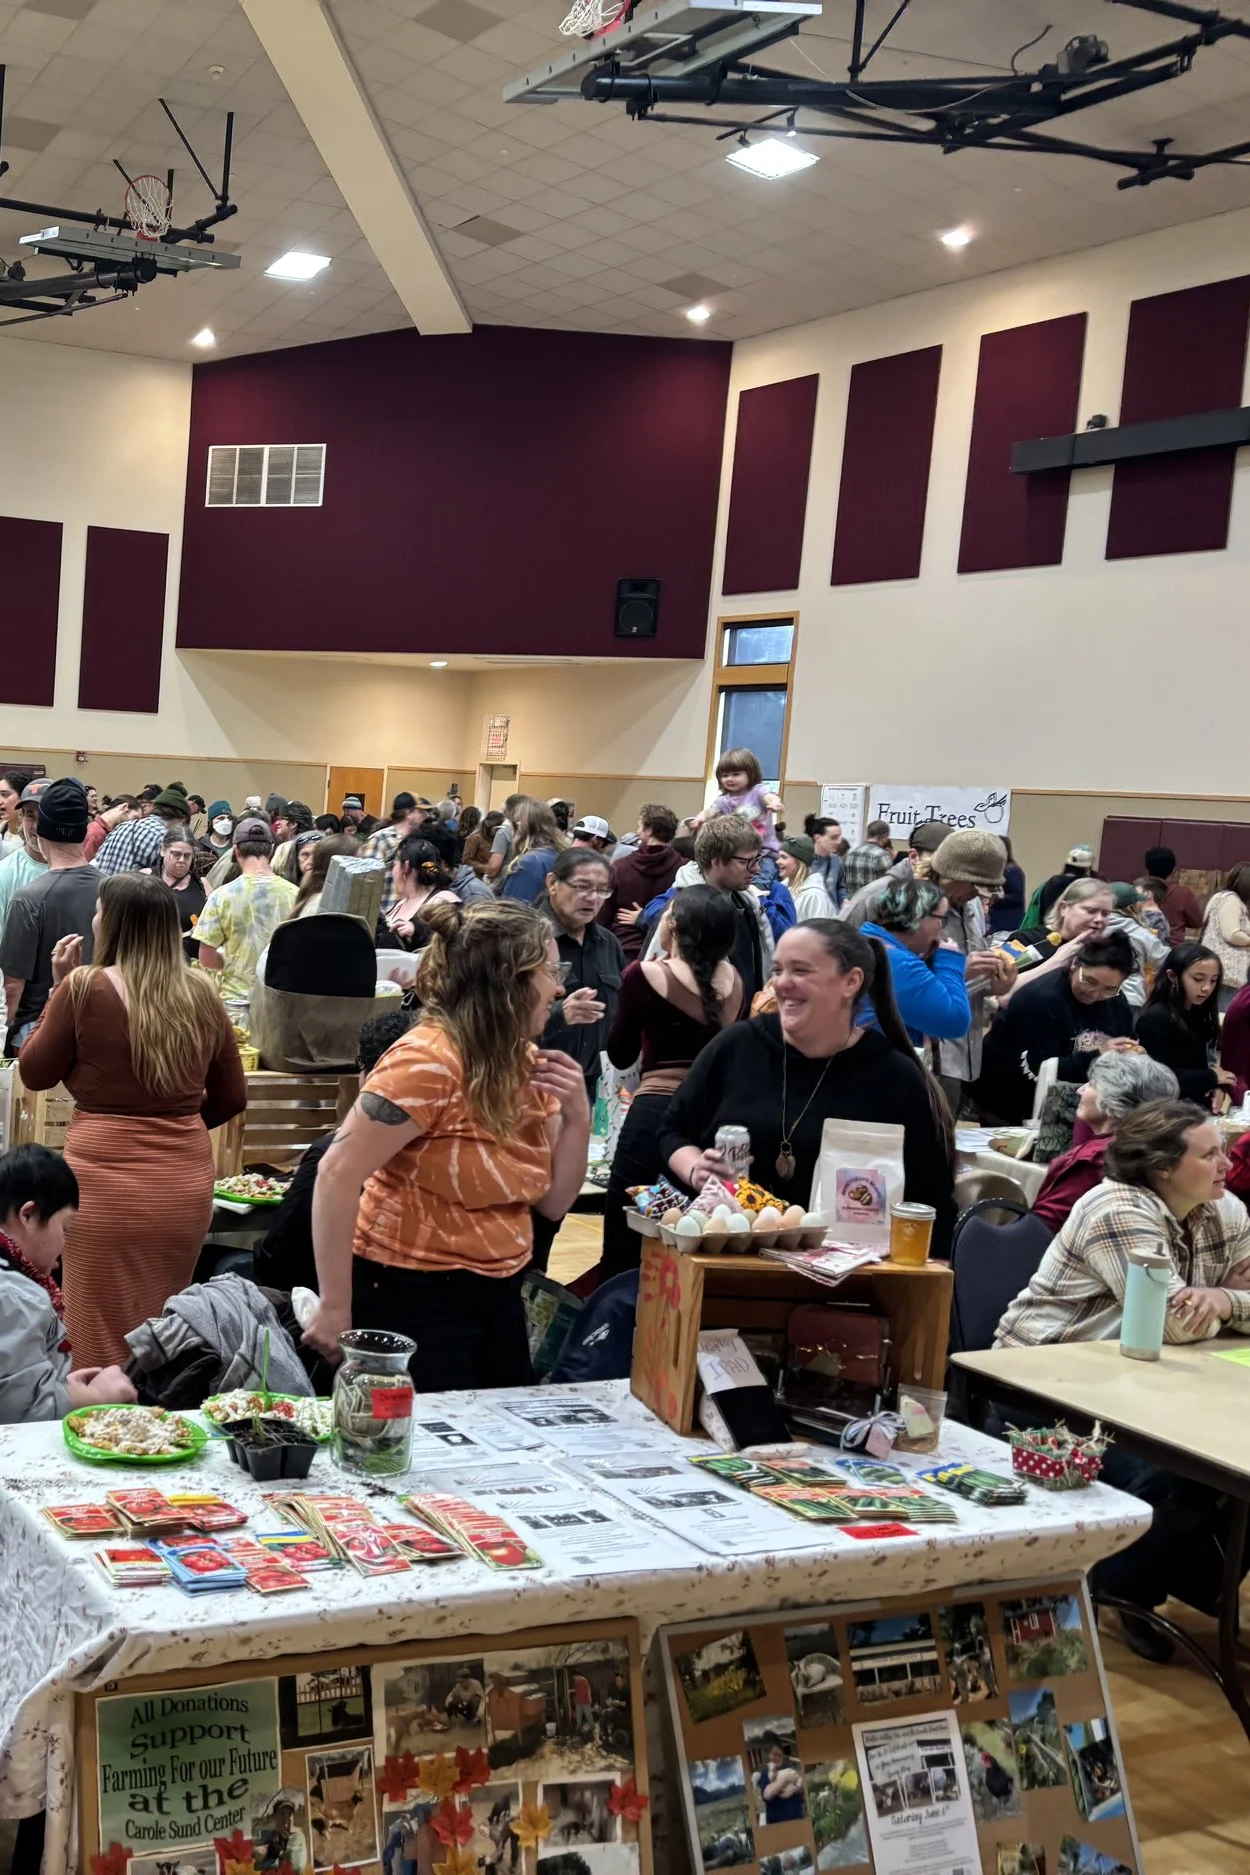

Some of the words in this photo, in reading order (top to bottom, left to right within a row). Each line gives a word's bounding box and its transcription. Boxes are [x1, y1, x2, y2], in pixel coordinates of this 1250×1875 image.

[877, 803, 920, 824] Fruit
[925, 805, 976, 829] Trees
[129, 1701, 154, 1729] All
[161, 1692, 249, 1716] Donations
[130, 1723, 251, 1759] Support
[102, 1755, 167, 1794] Farming
[170, 1755, 196, 1785] For
[199, 1756, 226, 1780] our
[228, 1746, 278, 1777] Future
[128, 1786, 171, 1816] at
[182, 1777, 249, 1814] the
[125, 1817, 166, 1841] Carole
[168, 1815, 202, 1839] Sund
[204, 1805, 246, 1834] Center
